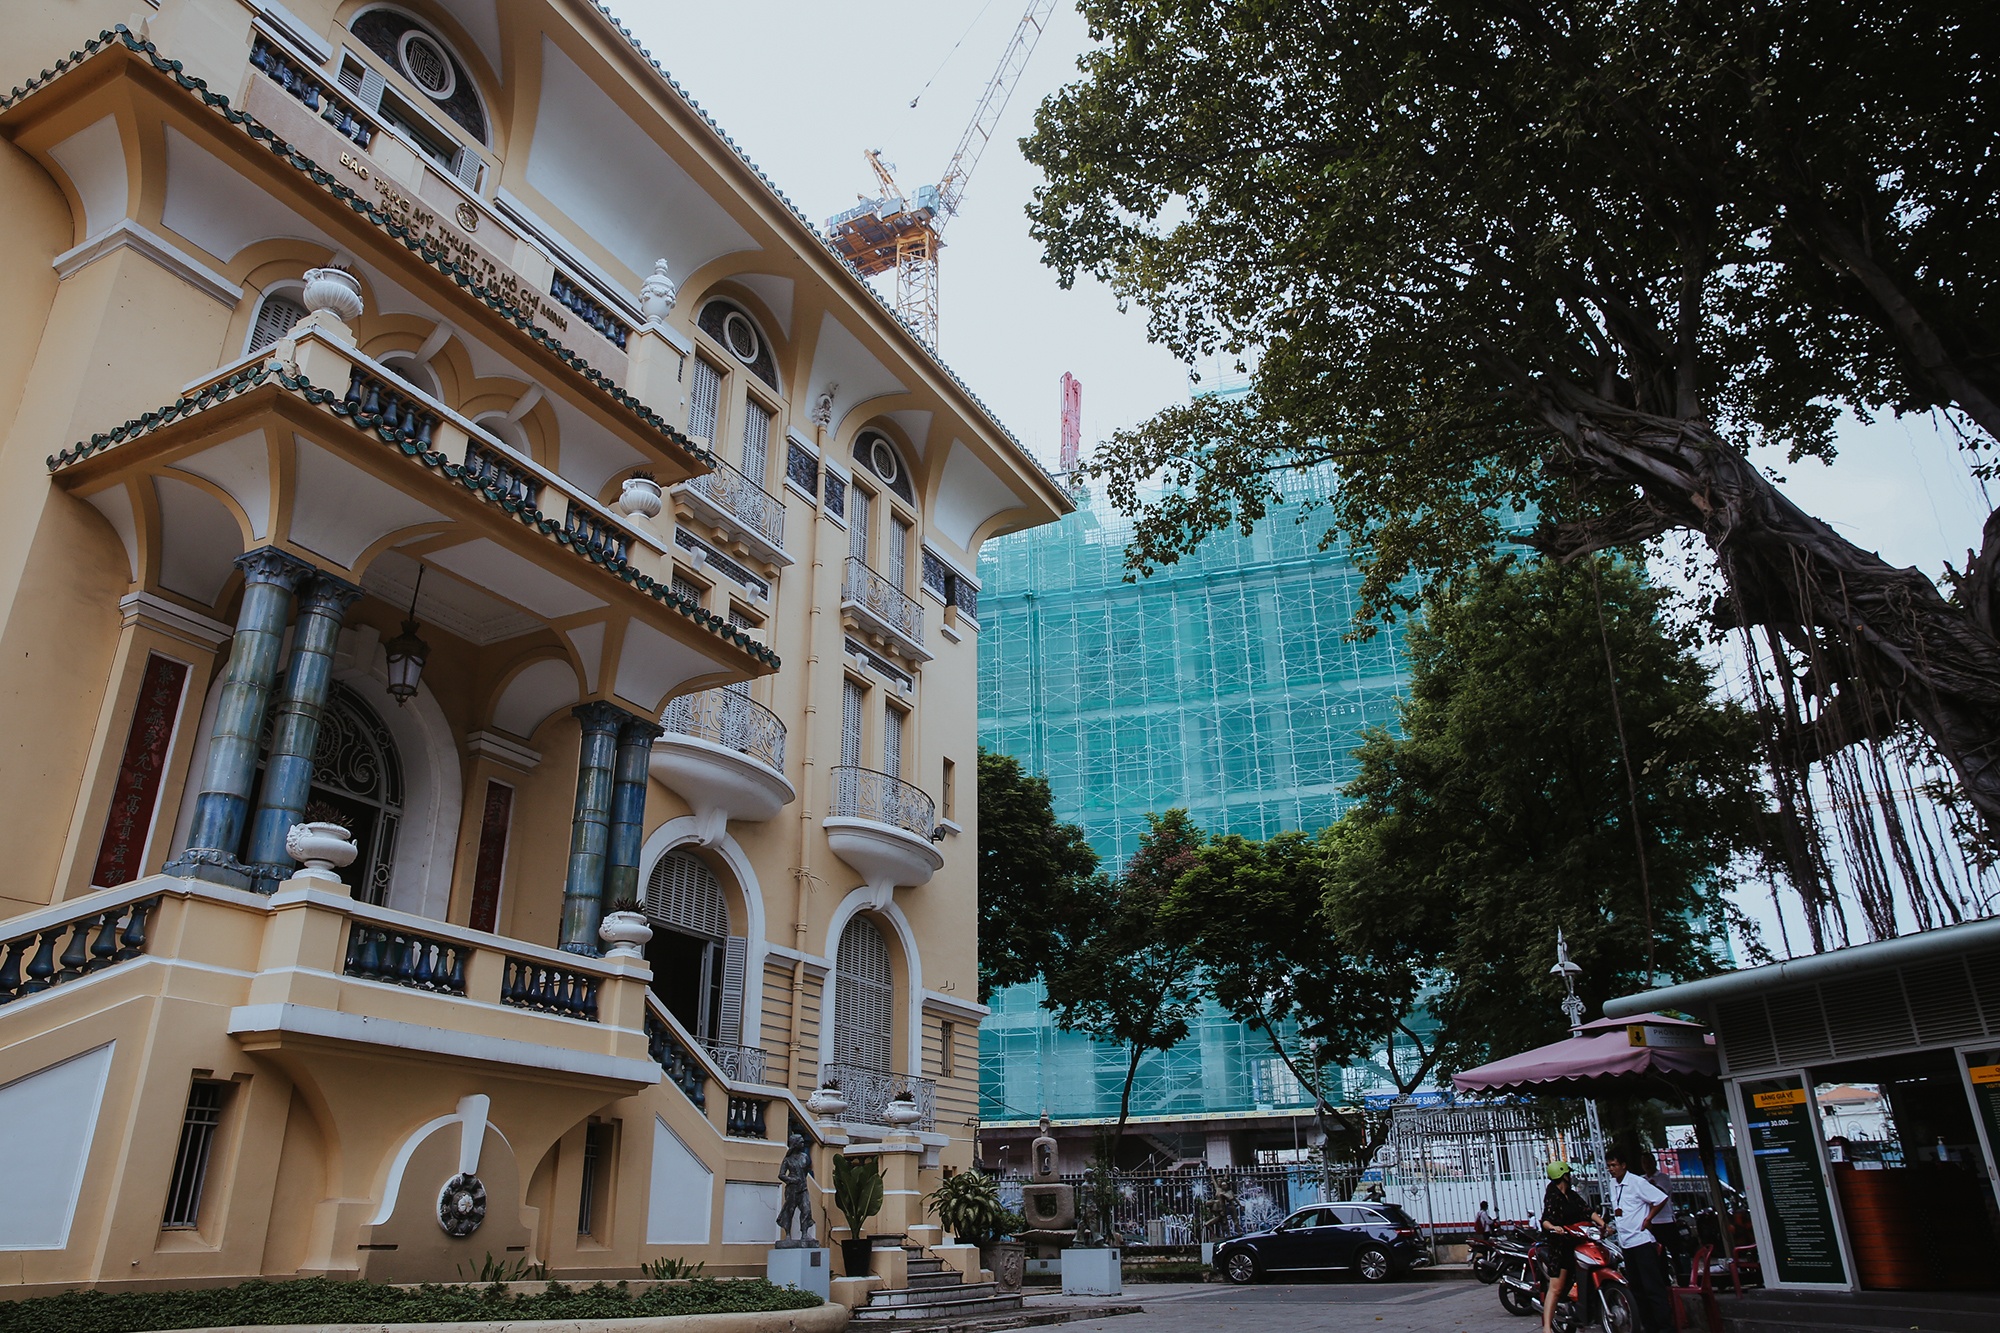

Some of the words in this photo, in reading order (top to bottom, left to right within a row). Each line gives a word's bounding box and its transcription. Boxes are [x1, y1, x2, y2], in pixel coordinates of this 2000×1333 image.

[424, 231, 451, 259] FINE
[455, 255, 484, 283] ARTS
[487, 278, 535, 320] MUSEUM
[540, 303, 568, 332] MINH
[1770, 1119, 1789, 1127] 30.000
